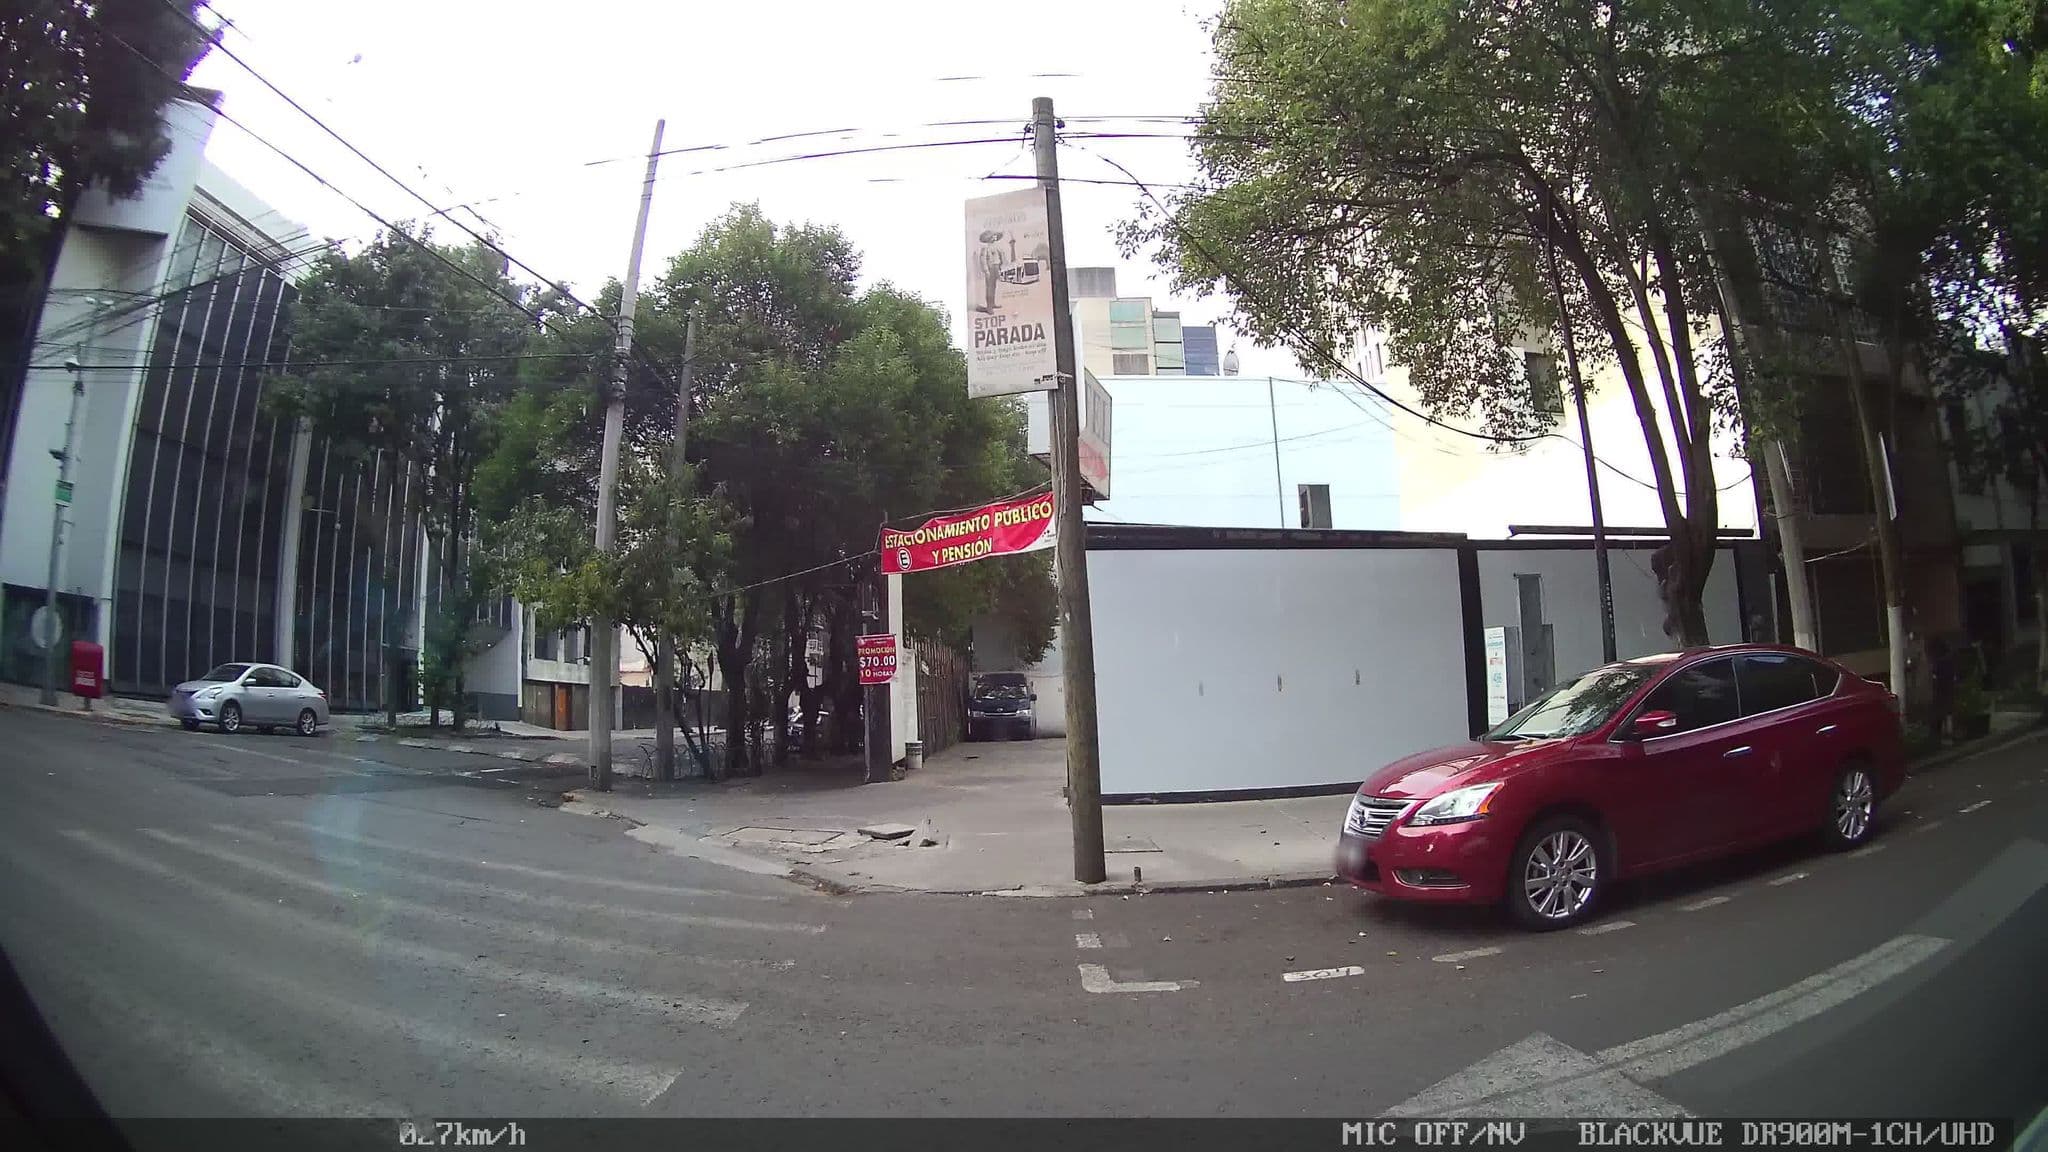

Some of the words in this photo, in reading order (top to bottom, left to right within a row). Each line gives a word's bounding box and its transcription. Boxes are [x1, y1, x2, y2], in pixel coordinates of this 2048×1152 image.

[975, 315, 1005, 329] STOP
[975, 323, 1045, 348] PARADA
[885, 515, 990, 549] ESTACIONAMIENTO
[994, 501, 1052, 527] PÚBLICO
[932, 550, 939, 565] Y
[942, 537, 992, 563] PENSIÓN
[860, 656, 896, 668] $70.00
[860, 669, 871, 678] 10
